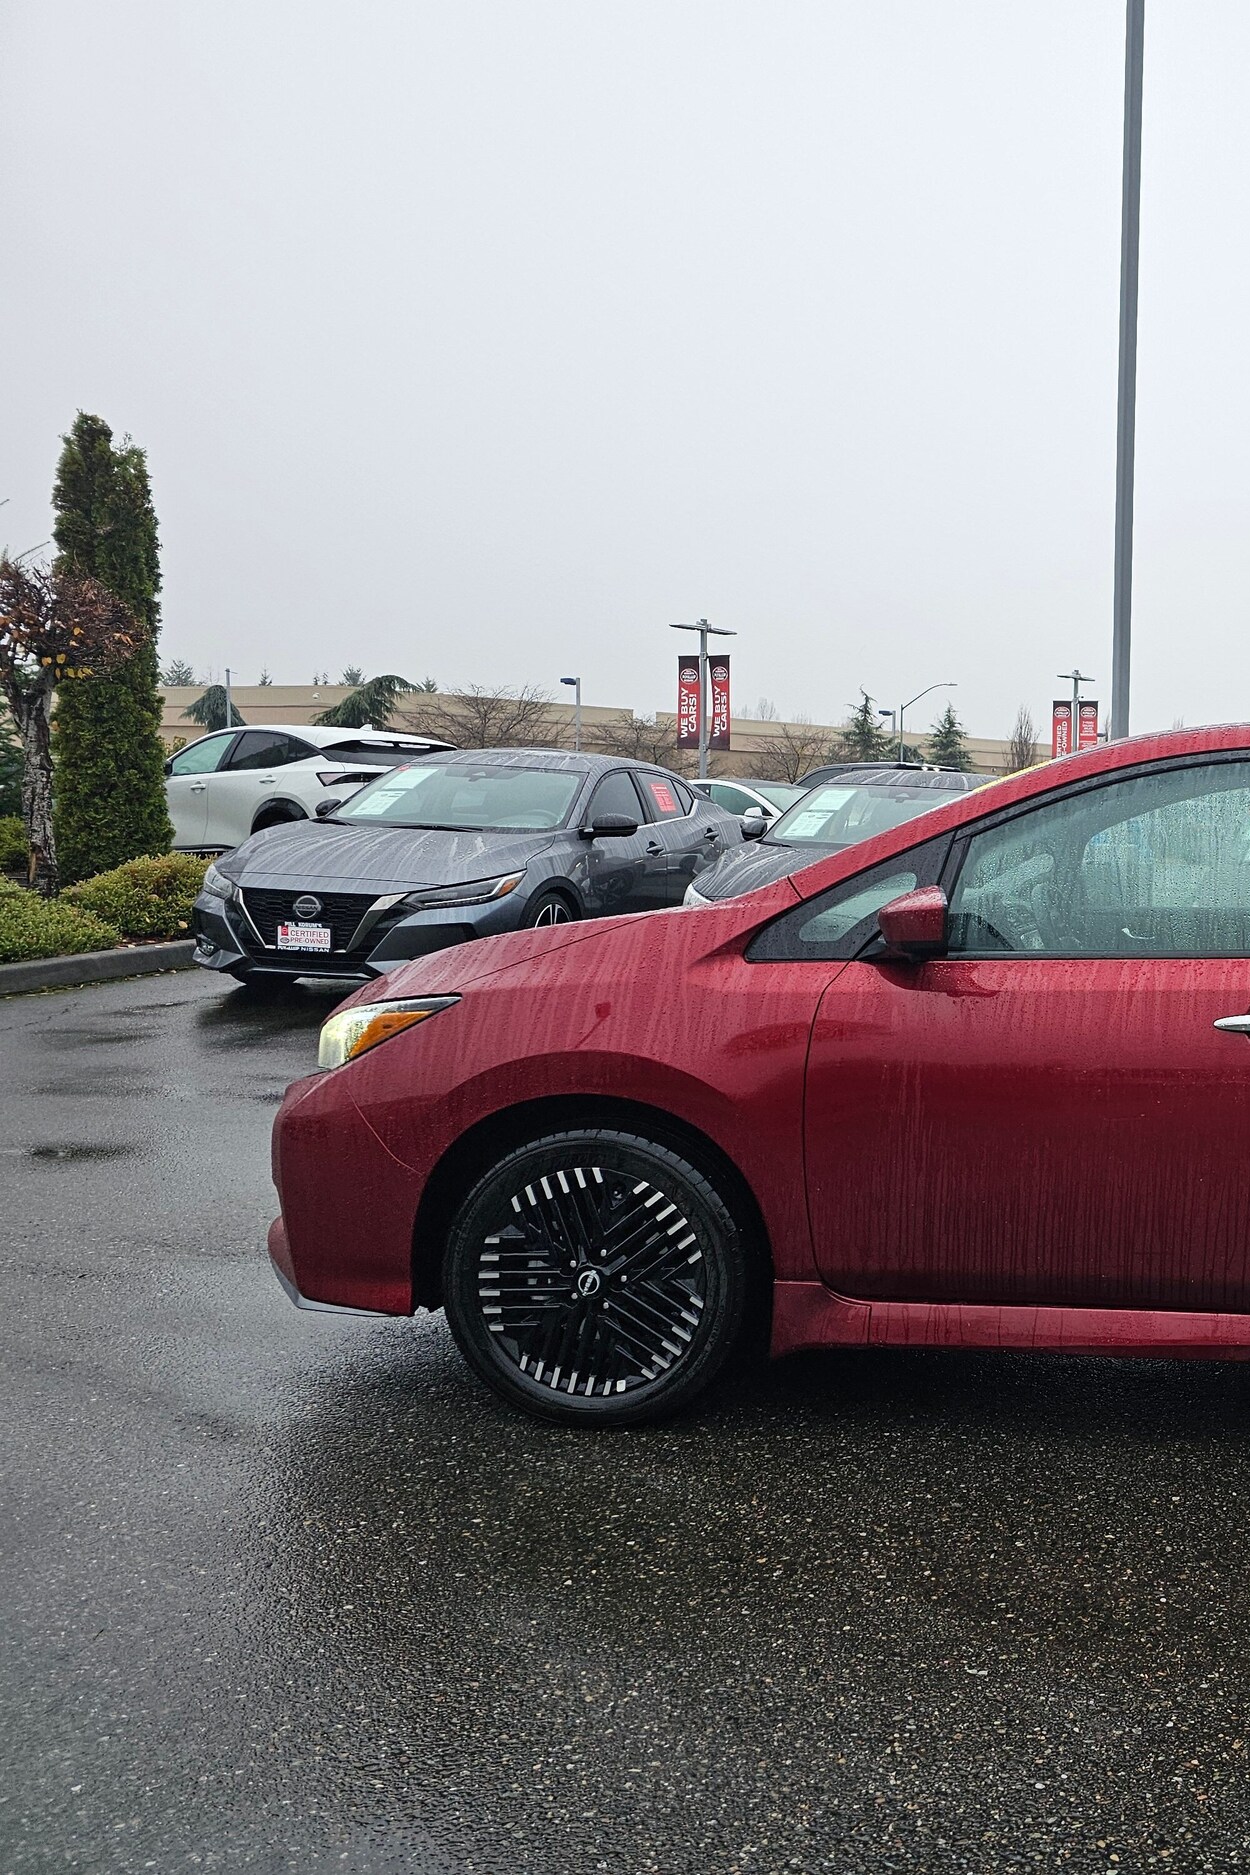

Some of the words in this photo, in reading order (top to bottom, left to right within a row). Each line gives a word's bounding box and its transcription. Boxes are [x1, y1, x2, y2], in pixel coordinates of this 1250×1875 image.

[680, 687, 689, 714] BUY
[713, 685, 721, 713] BUY
[720, 691, 728, 731] CARS!
[688, 693, 697, 732] CARS!
[680, 717, 689, 738] WE
[713, 716, 721, 737] WE
[290, 929, 329, 938] CERTIFIED
[290, 936, 329, 945] PRE-OWNED
